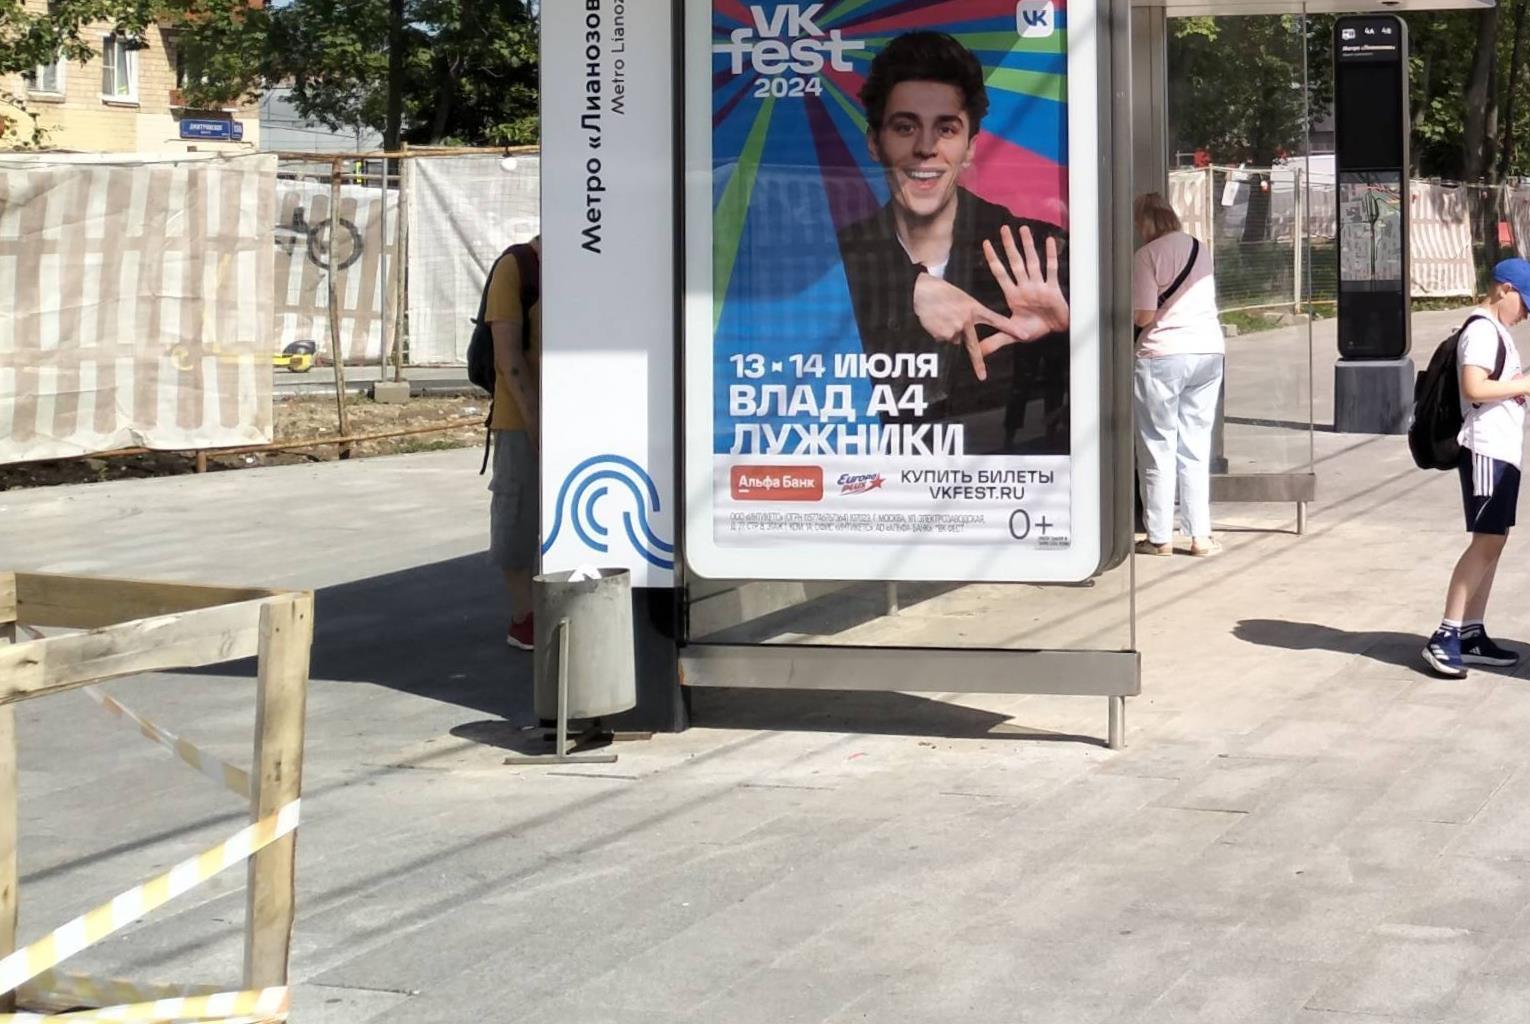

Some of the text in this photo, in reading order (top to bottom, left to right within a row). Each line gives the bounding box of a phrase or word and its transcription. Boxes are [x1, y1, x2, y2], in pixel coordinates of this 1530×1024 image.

[750, 3, 825, 38] VK
[1022, 10, 1048, 27] VK
[711, 28, 865, 75] fest
[611, 59, 625, 115] Metro
[754, 77, 823, 98] 2024
[581, 157, 605, 254] Метро
[729, 353, 765, 378] 13
[789, 353, 826, 378] 14
[834, 353, 939, 378] ИЮЛЯ
[729, 384, 928, 422] ВЛАД А4
[729, 423, 965, 456] ЛУЖНИКИ
[738, 475, 815, 493] Альфа Банк
[901, 470, 1054, 484] КУПИТЬ БИЛЕТЫ
[929, 486, 1025, 500] VKFEST.RU
[1009, 508, 1054, 540] 0+
